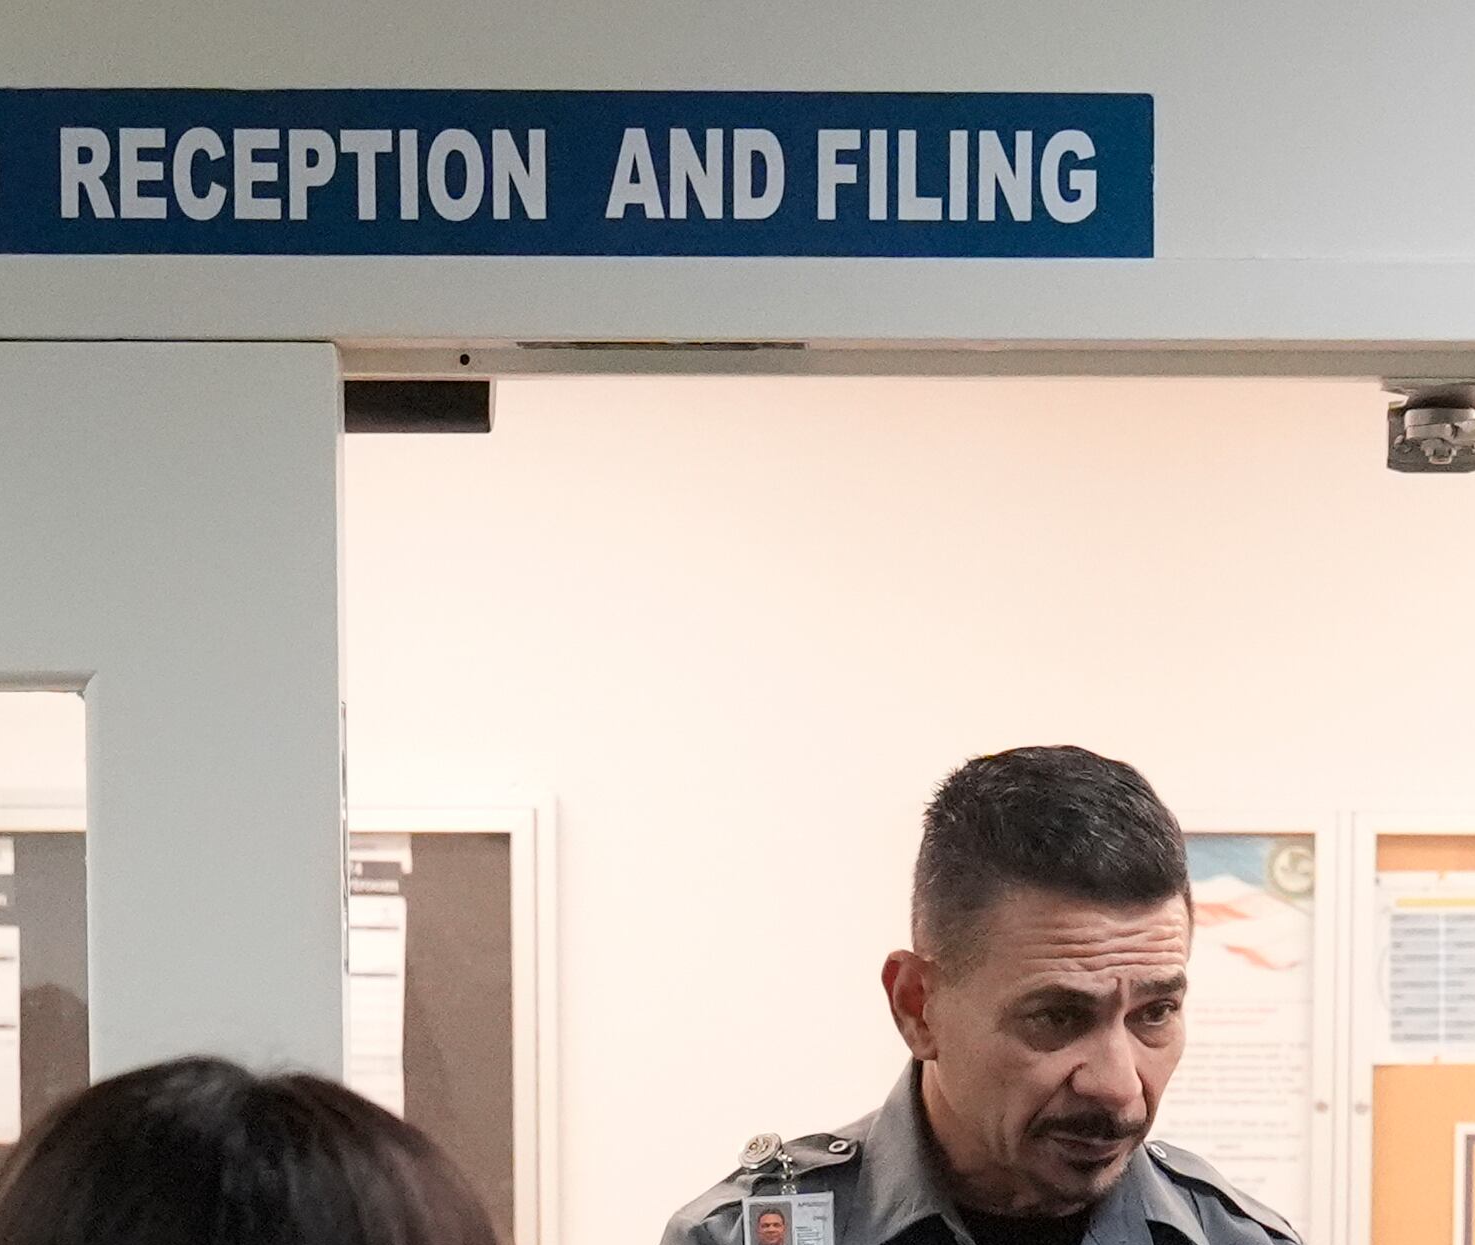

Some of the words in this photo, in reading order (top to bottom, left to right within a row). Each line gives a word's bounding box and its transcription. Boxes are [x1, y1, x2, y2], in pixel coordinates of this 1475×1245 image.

[60, 127, 547, 221] RECEPTION
[605, 128, 785, 220] AND
[817, 129, 1097, 224] FILING
